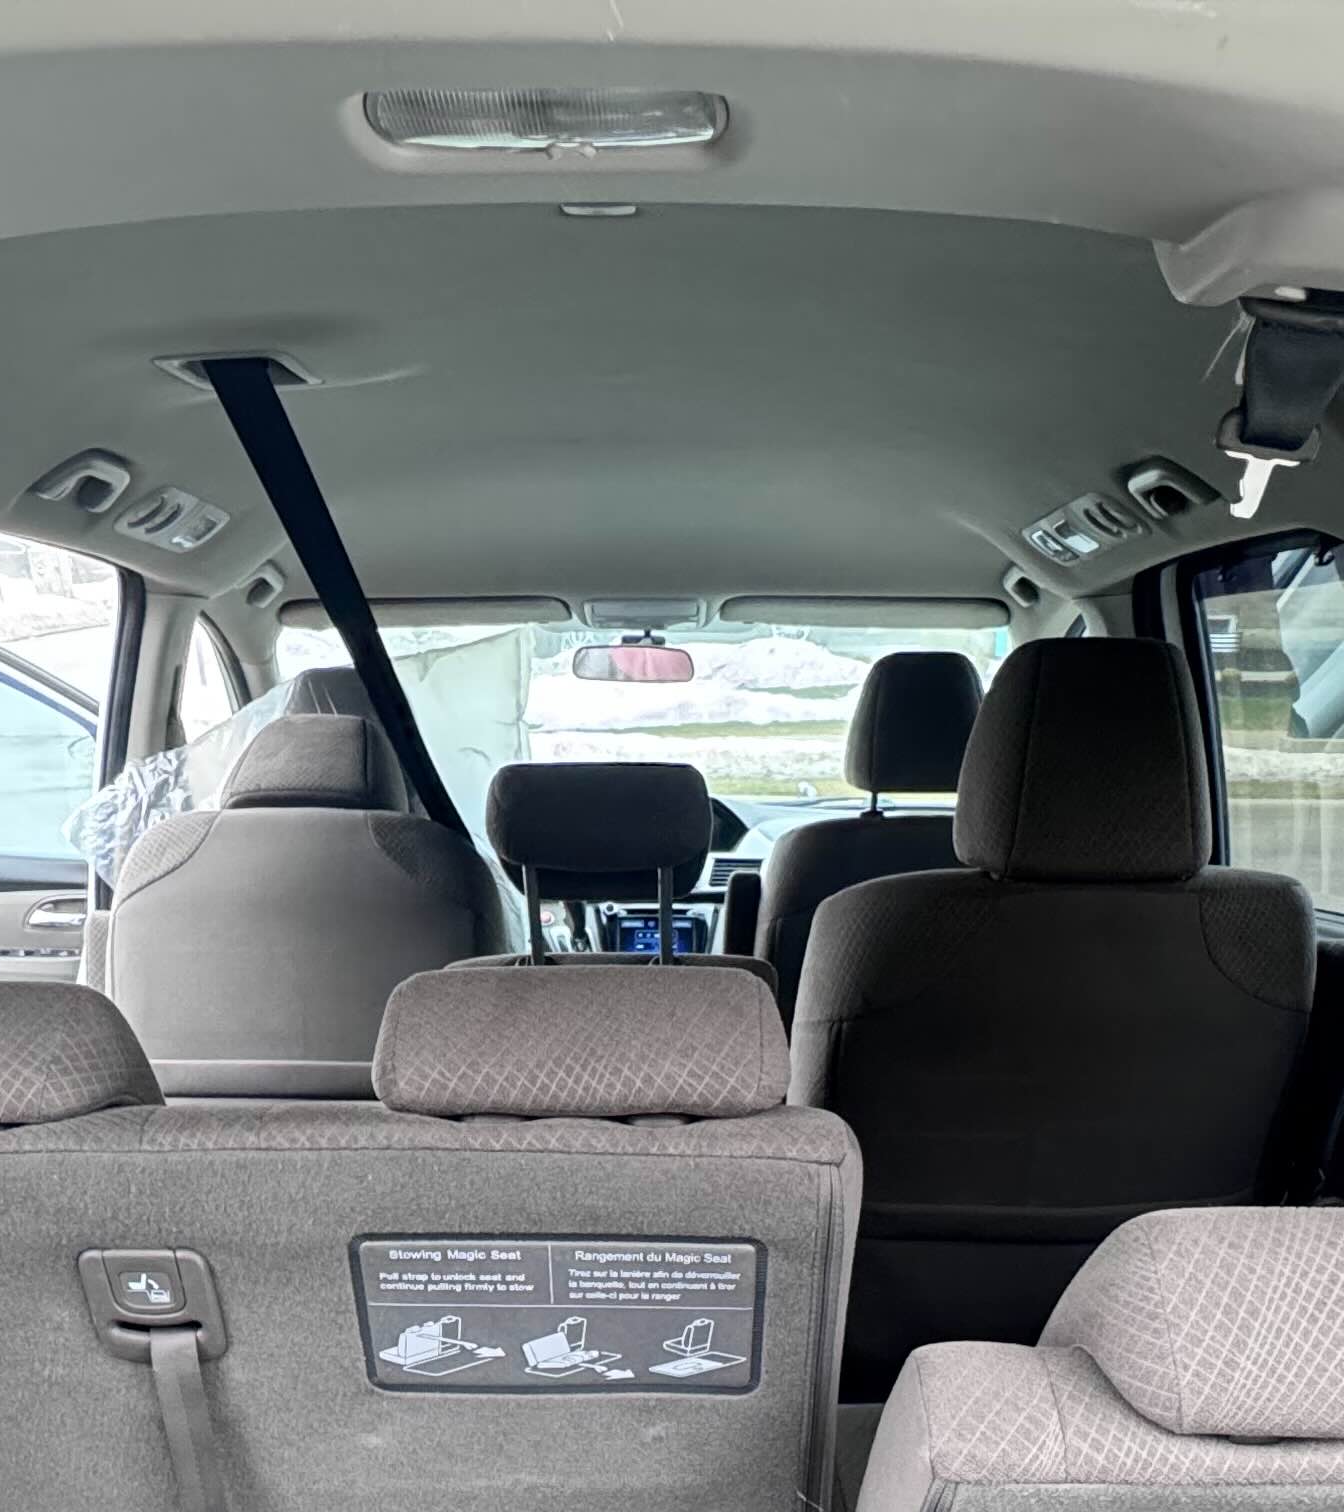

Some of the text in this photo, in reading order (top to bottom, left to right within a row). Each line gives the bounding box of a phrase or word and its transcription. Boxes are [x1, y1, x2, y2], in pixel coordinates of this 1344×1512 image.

[447, 1250, 486, 1261] Magic
[490, 1250, 522, 1260] Seat
[575, 1250, 732, 1264] Rangement du Magic Seat
[379, 1272, 526, 1282] Pull strap to unlock seat and
[380, 1282, 535, 1293] continue pulling firmly to stow
[629, 1281, 645, 1289] tout
